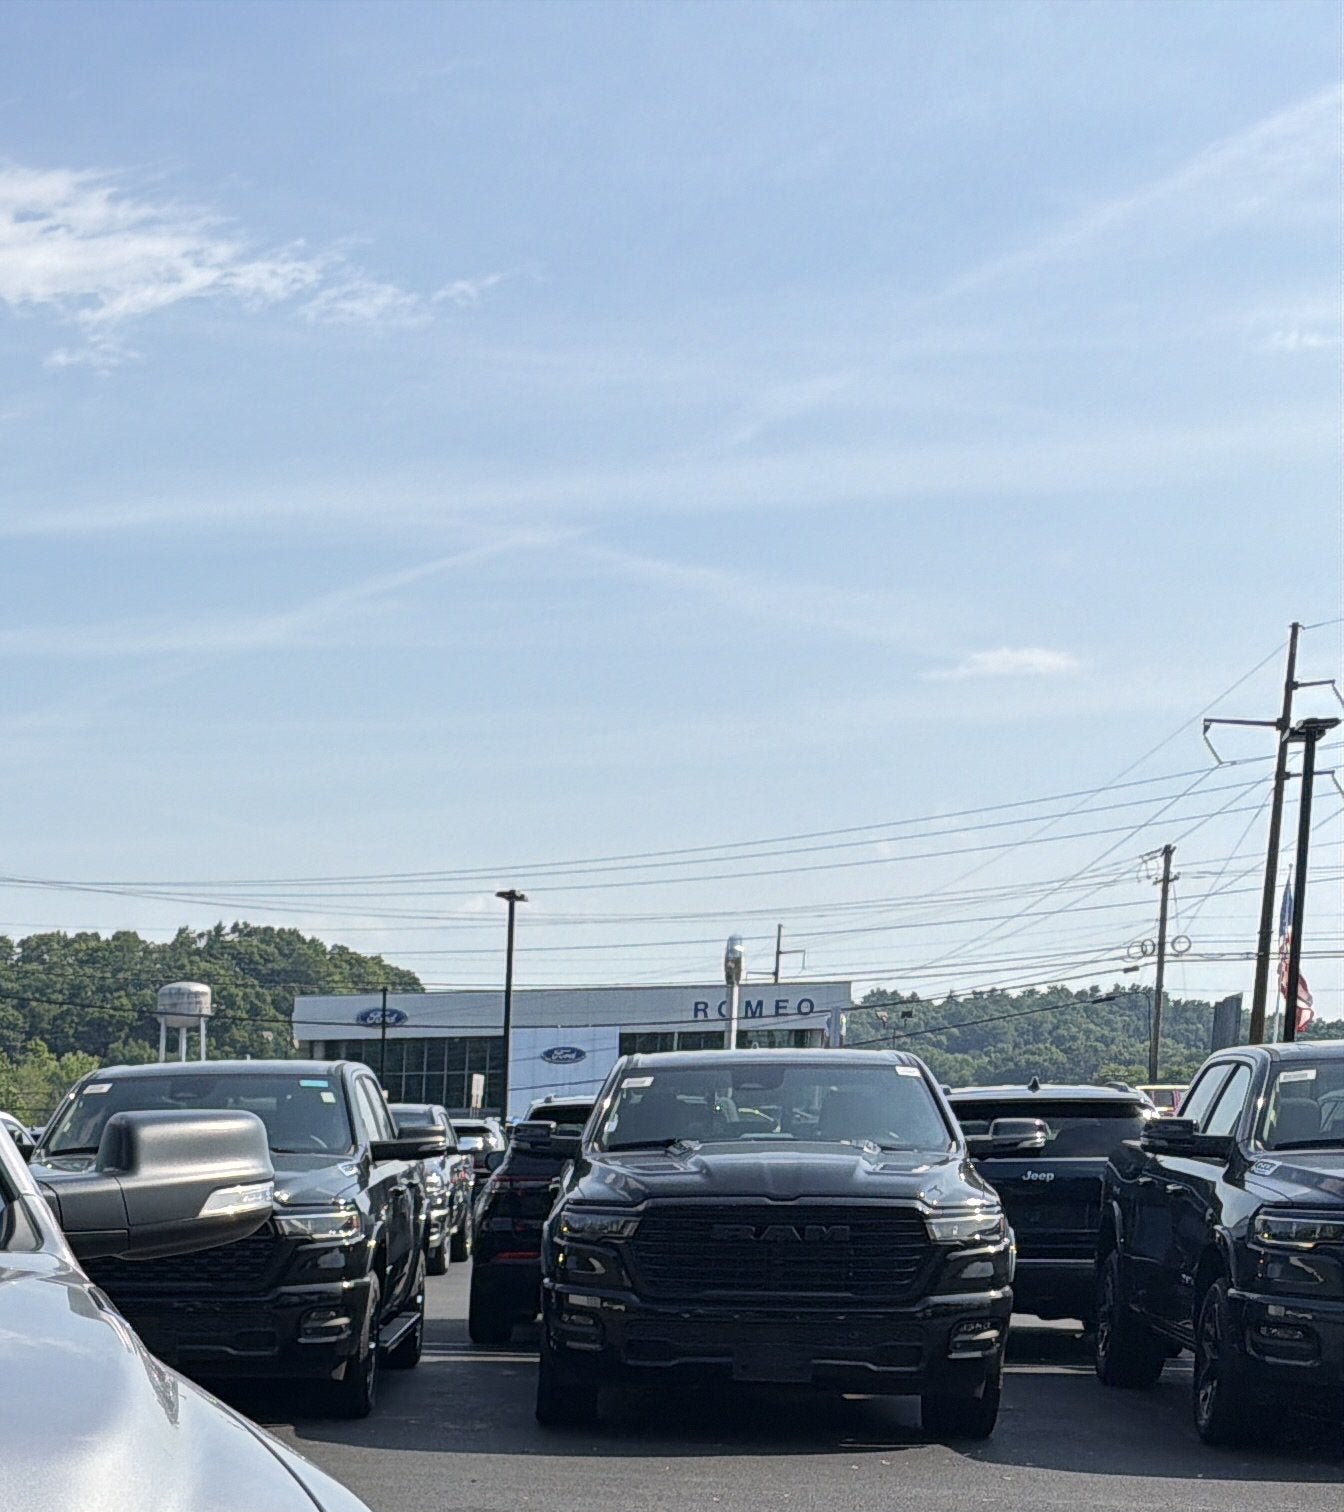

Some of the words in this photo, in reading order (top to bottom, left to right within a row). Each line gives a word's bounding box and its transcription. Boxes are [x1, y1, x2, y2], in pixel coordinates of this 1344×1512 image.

[693, 998, 815, 1019] ROMEO
[1022, 1170, 1055, 1183] Jeep
[712, 1225, 850, 1241] RAM
